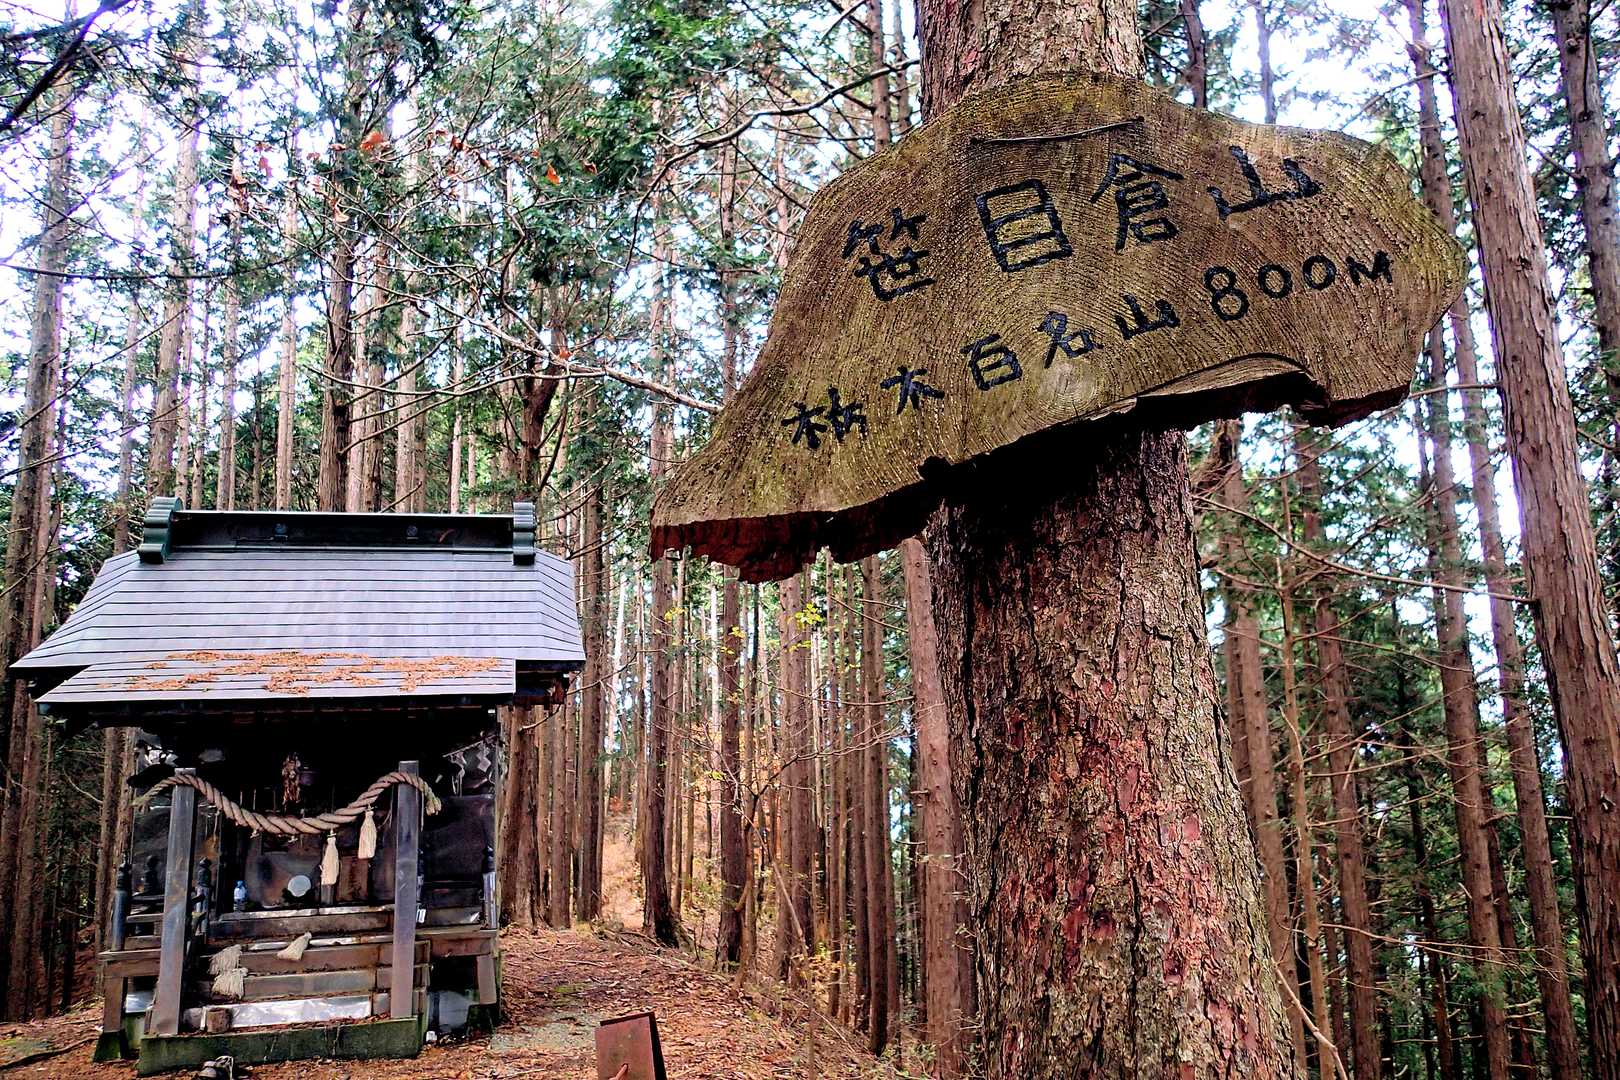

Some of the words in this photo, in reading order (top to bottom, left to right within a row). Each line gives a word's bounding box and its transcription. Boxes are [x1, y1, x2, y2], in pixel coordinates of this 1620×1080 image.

[842, 146, 1321, 301] 笹目倉山
[781, 294, 1180, 449] 栃木百名山
[1204, 251, 1393, 321] 800M
